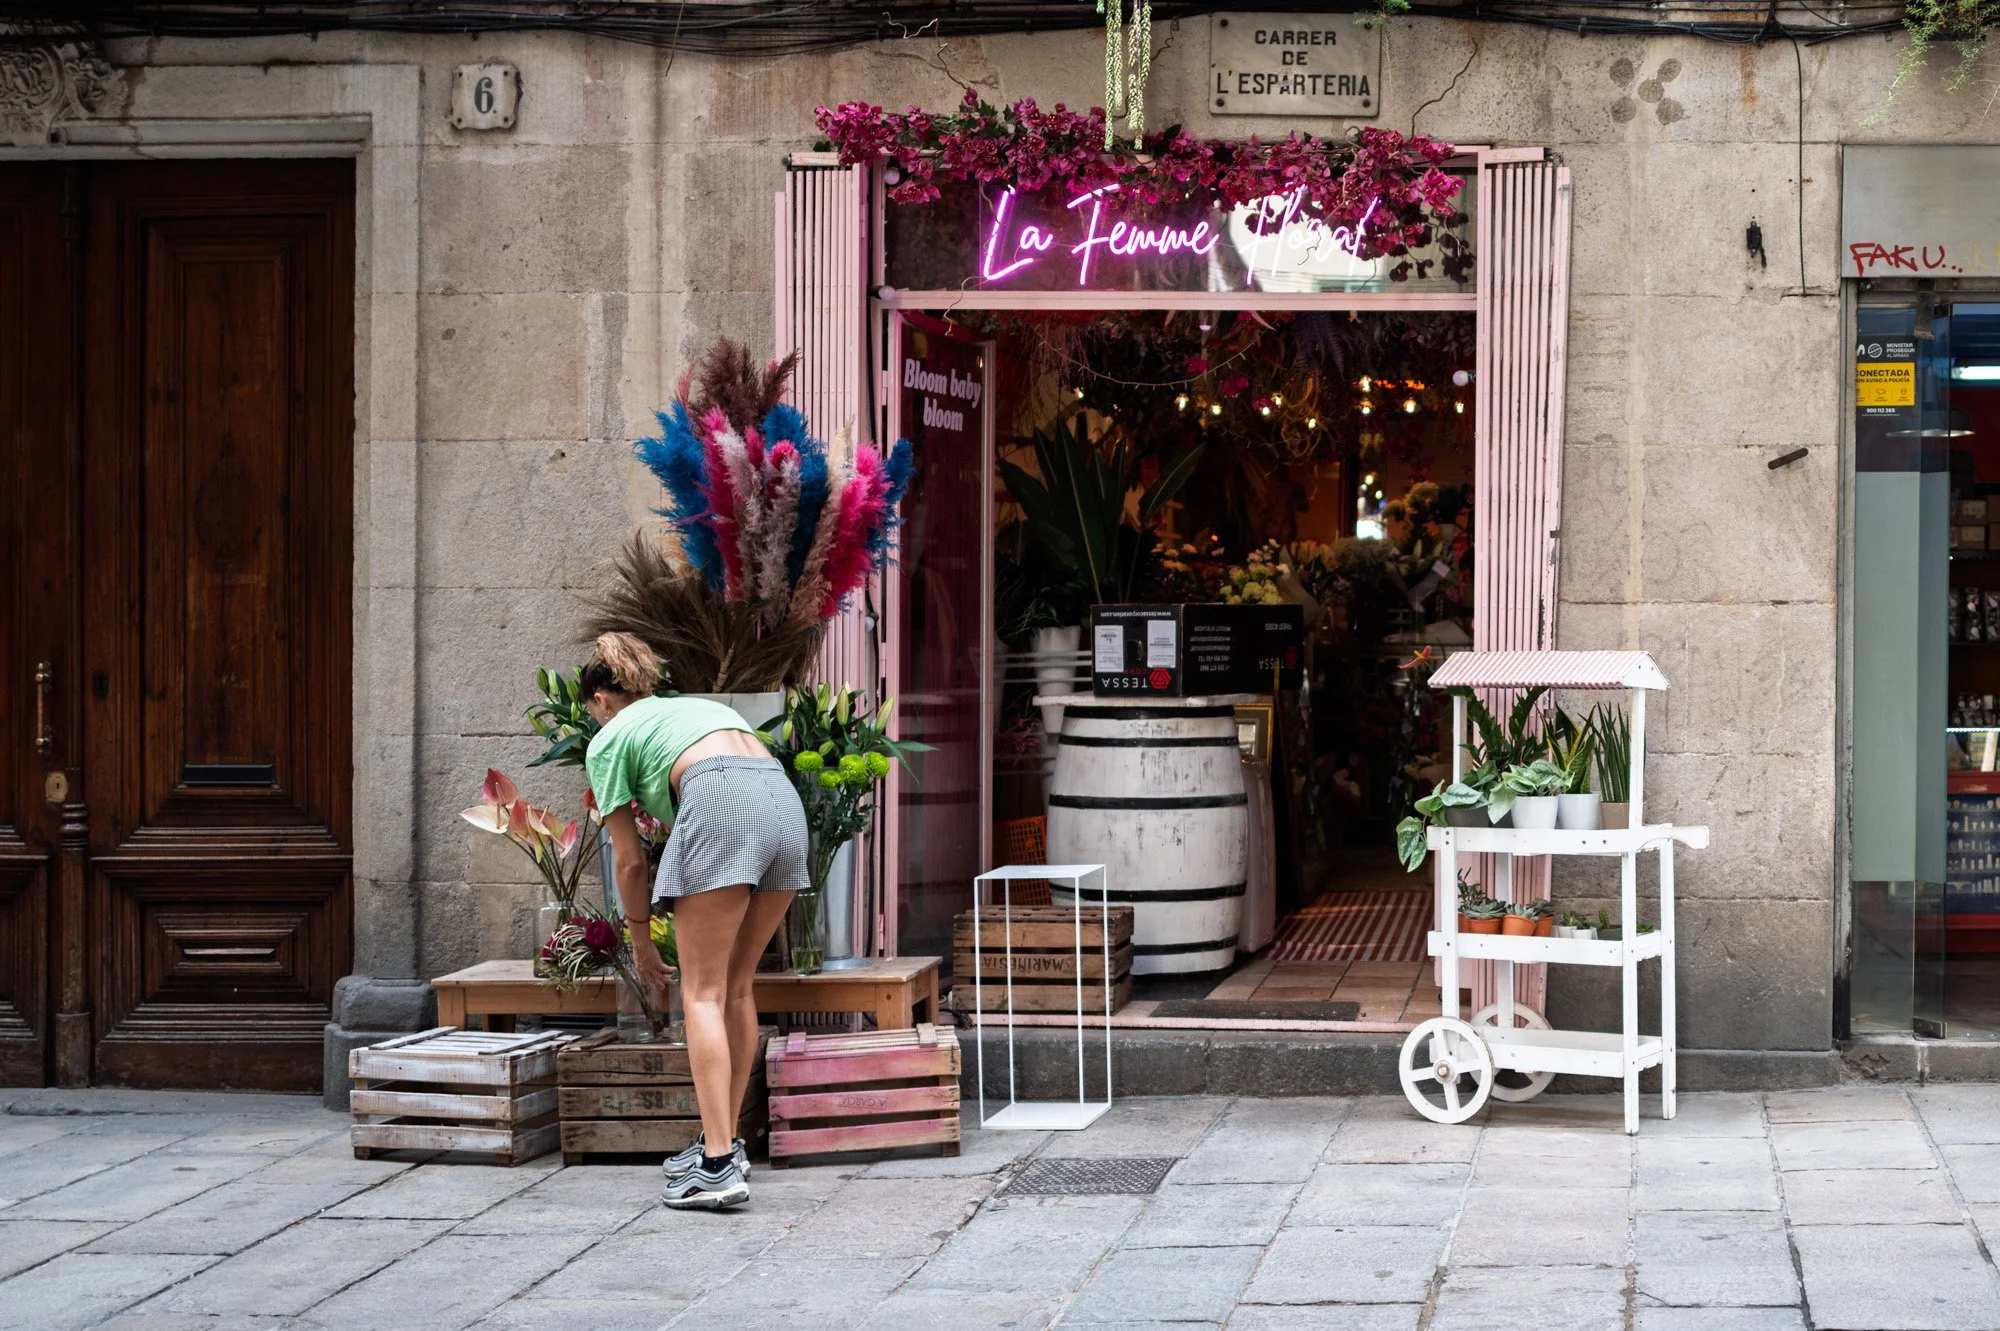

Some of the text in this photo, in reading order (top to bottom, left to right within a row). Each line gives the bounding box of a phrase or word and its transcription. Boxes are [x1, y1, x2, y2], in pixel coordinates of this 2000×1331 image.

[1254, 30, 1337, 46] CARRER
[1281, 51, 1309, 66] DE
[1216, 70, 1371, 96] L'ESPARTERIA
[474, 76, 494, 114] 6
[983, 184, 1054, 281] La
[1066, 183, 1220, 286] Femme
[903, 358, 982, 409] Bloom baby
[923, 396, 964, 432] bloom
[1100, 610, 1172, 618] www.tessacorporation.com
[1258, 658, 1285, 670] TSSA
[1101, 677, 1148, 688] TESSA
